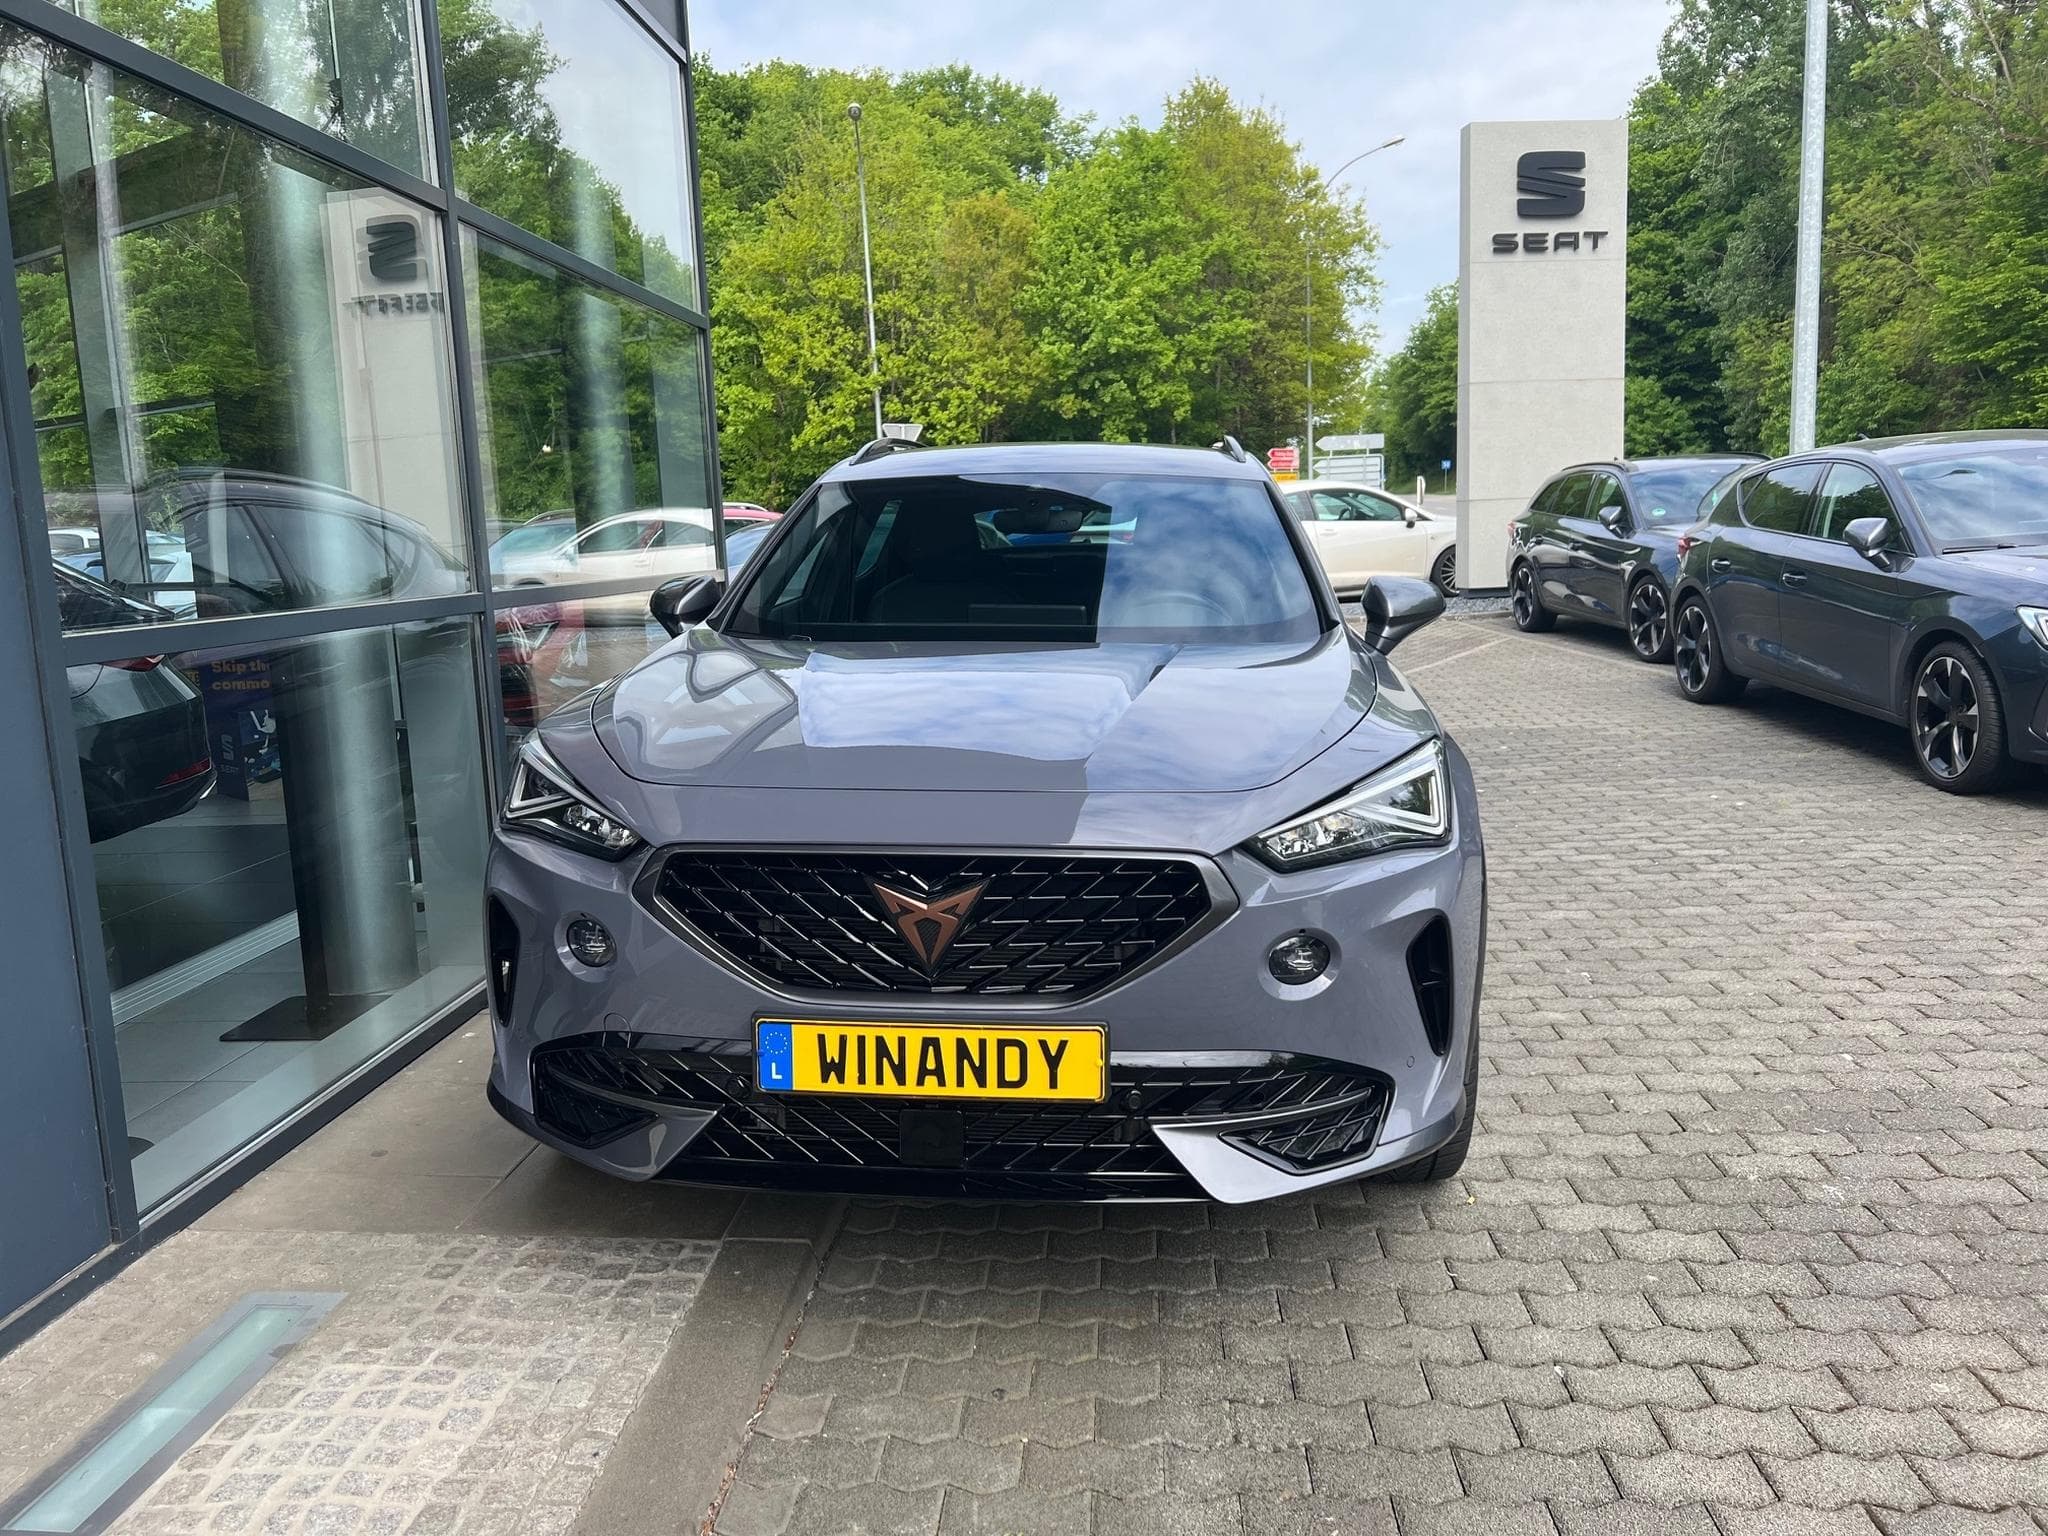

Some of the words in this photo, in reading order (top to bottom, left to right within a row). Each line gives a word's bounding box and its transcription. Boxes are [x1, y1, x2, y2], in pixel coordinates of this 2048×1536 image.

[1492, 231, 1609, 254] SEAT
[211, 660, 246, 674] Skip
[771, 1062, 782, 1079] L
[816, 1033, 1069, 1089] WINANDY
